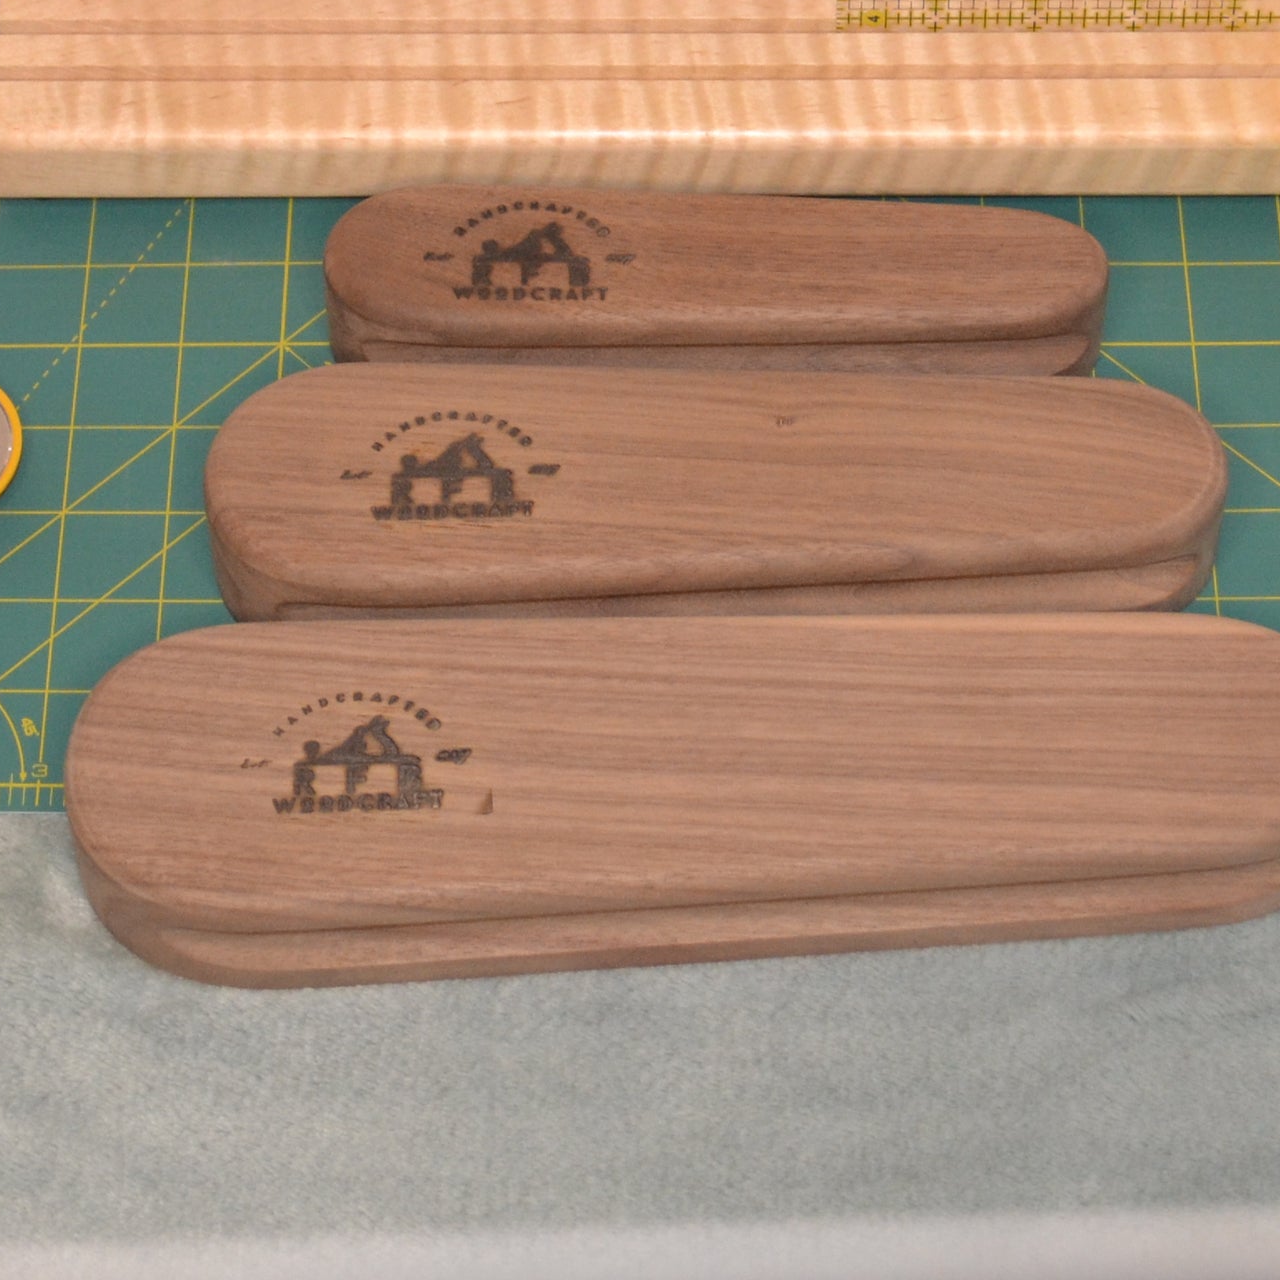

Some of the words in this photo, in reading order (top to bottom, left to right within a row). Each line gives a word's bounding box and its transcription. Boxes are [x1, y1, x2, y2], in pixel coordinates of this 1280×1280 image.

[452, 286, 609, 301] WOODCRAFT
[370, 499, 535, 521] WOODCRAFT
[272, 691, 442, 737] HANDCRAFTED
[32, 764, 48, 777] 3
[271, 788, 445, 814] WOODCRAFT
